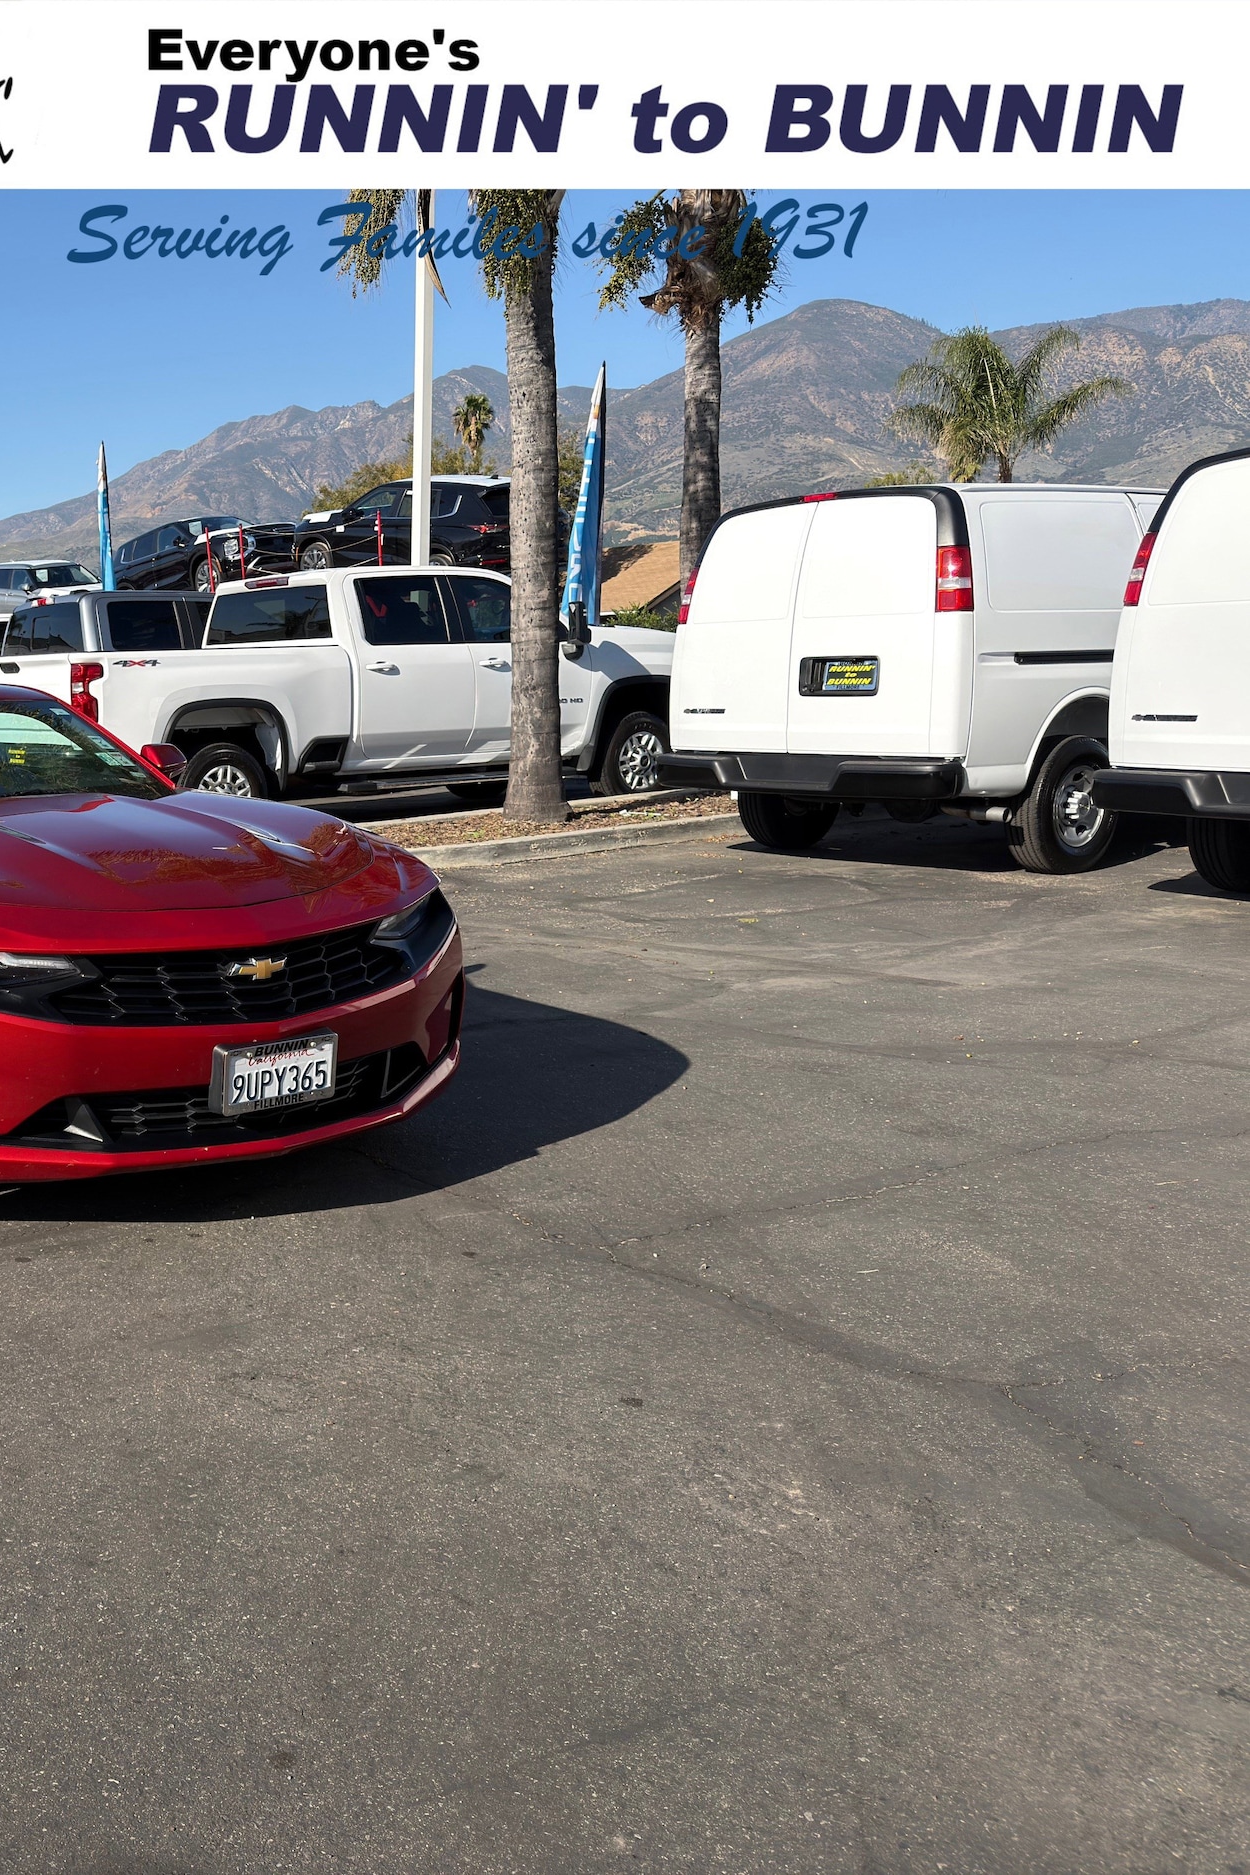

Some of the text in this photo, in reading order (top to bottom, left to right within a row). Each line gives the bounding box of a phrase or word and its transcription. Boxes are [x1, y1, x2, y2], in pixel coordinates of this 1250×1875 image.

[254, 1039, 309, 1057] BUNNIN
[232, 1060, 327, 1104] 9UPY365
[254, 1093, 304, 1110] FILLMORE
